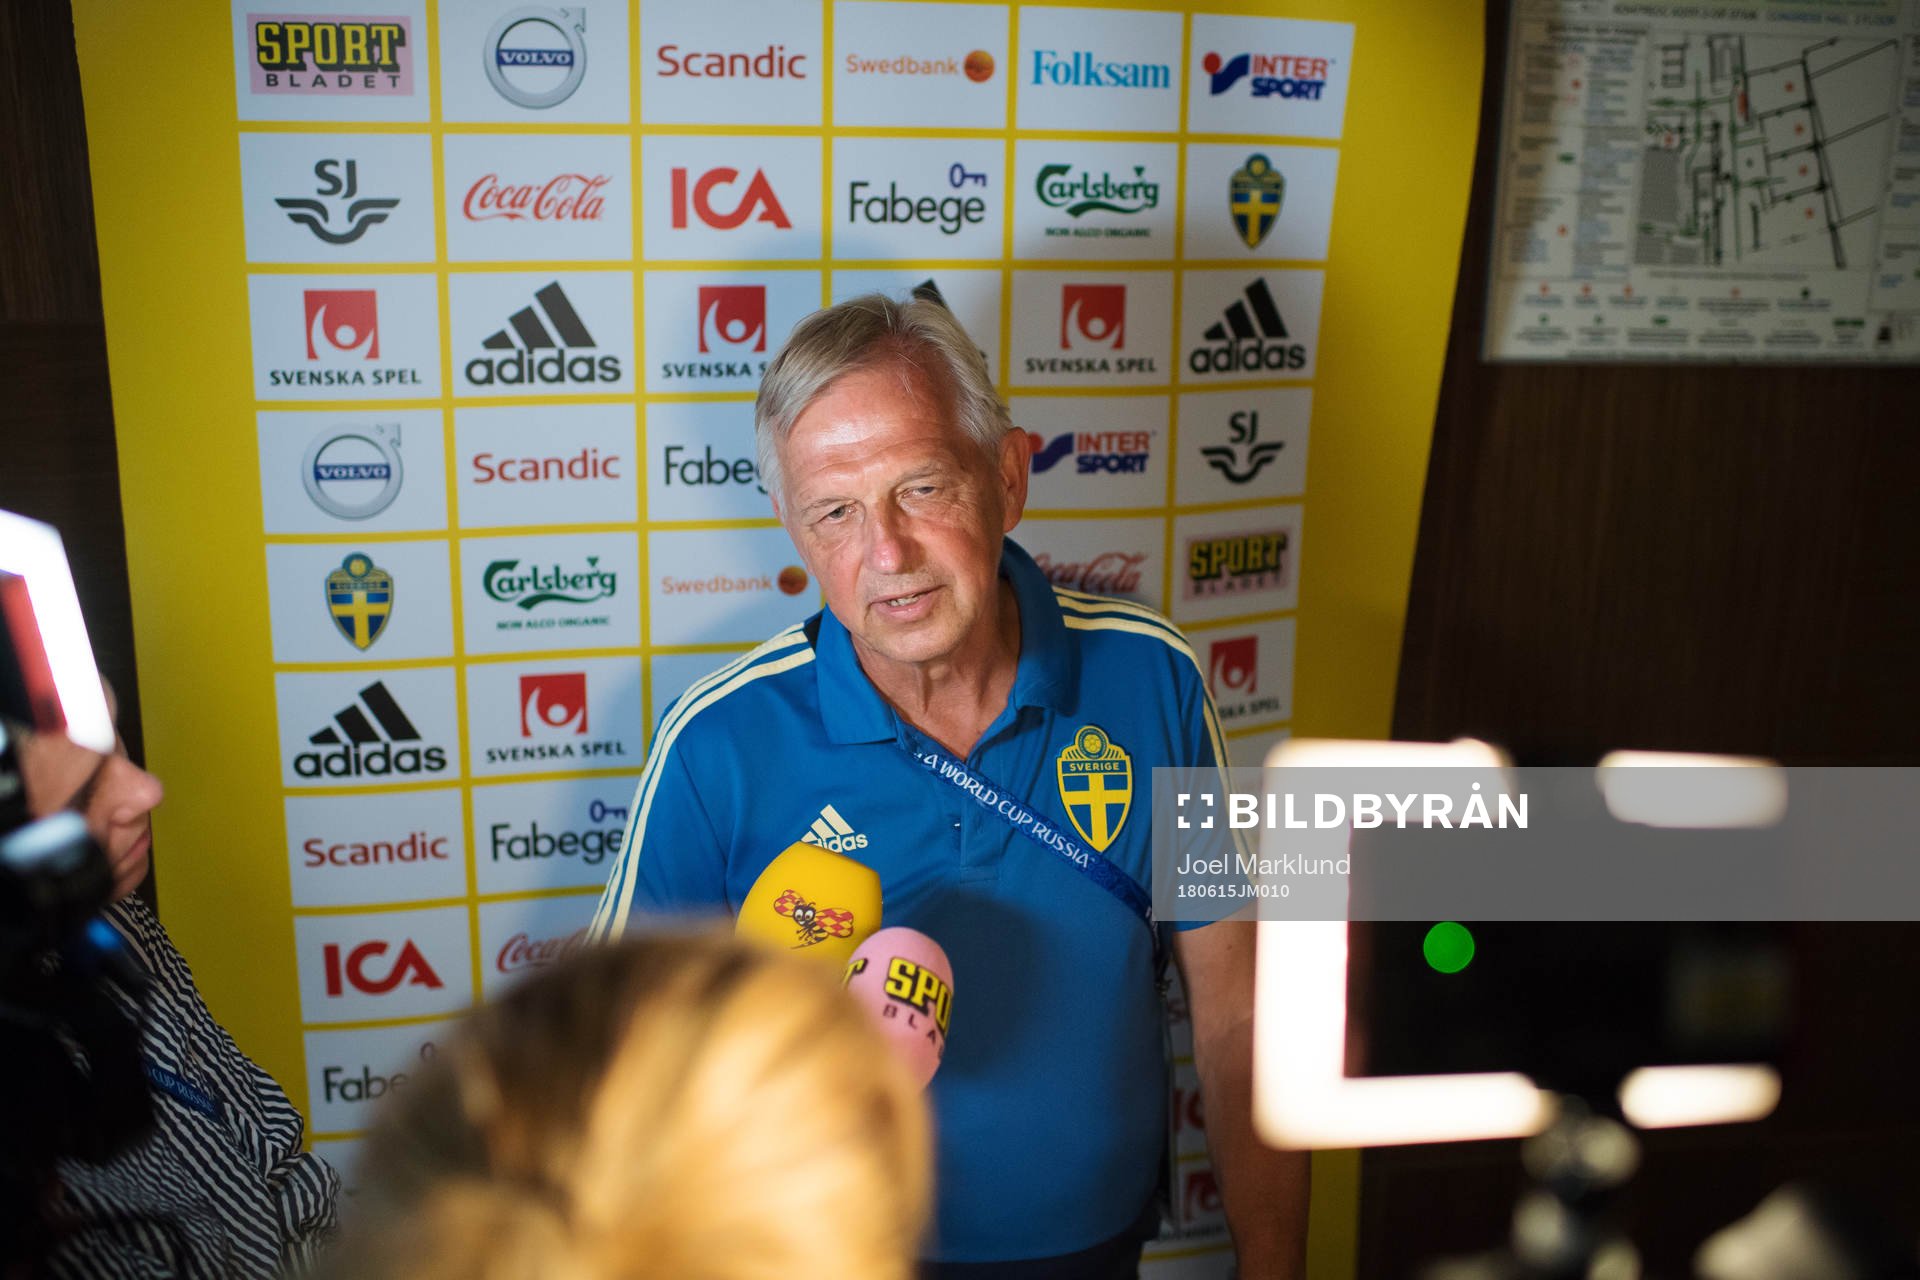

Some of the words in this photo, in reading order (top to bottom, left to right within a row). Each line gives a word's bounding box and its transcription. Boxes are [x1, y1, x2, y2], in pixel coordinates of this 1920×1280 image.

[256, 22, 405, 72] SPORT
[500, 50, 572, 66] VOLVO
[657, 45, 807, 79] Scandic
[845, 53, 959, 76] Swedbank
[265, 73, 401, 89] BLADET
[1032, 50, 1171, 89] Folksam
[1252, 54, 1329, 80] INTER
[1251, 76, 1326, 101] SPORT
[314, 159, 358, 199] SJ
[1035, 164, 1159, 211] Carlsberg
[463, 173, 613, 222] Coca-Cola
[671, 167, 793, 230] ICA
[849, 181, 986, 235] Fabege
[465, 347, 622, 386] adidas
[661, 361, 752, 379] SVENSKA
[1025, 358, 1111, 374] SVENSKA
[1116, 358, 1157, 374] SPEL
[1189, 337, 1307, 374] adidas
[269, 369, 366, 387] SVENSKA
[372, 369, 422, 386] SPEL
[1077, 431, 1150, 453] INTER
[1230, 411, 1259, 445] SJ
[315, 463, 392, 481] VOLVO
[473, 448, 620, 484] Scandic
[664, 445, 768, 494] Fabe
[1076, 453, 1150, 475] SPORT
[1190, 532, 1288, 580] SPORT
[484, 558, 616, 601] Carlsberg
[662, 574, 773, 597] Swedbank
[295, 741, 446, 778] adidas
[487, 744, 574, 763] SVENSKA
[581, 740, 626, 757] SPEL
[1069, 761, 1120, 772] SVERIGE
[940, 760, 999, 806] WORLD
[998, 799, 1034, 826] CUP
[1031, 821, 1091, 869] RUSSIA
[303, 832, 448, 867] Scandic
[491, 820, 624, 865] Fabege
[812, 833, 868, 853] idas
[323, 939, 444, 997] ICA
[884, 956, 953, 1039] SPO
[323, 1064, 409, 1104] Fabe
